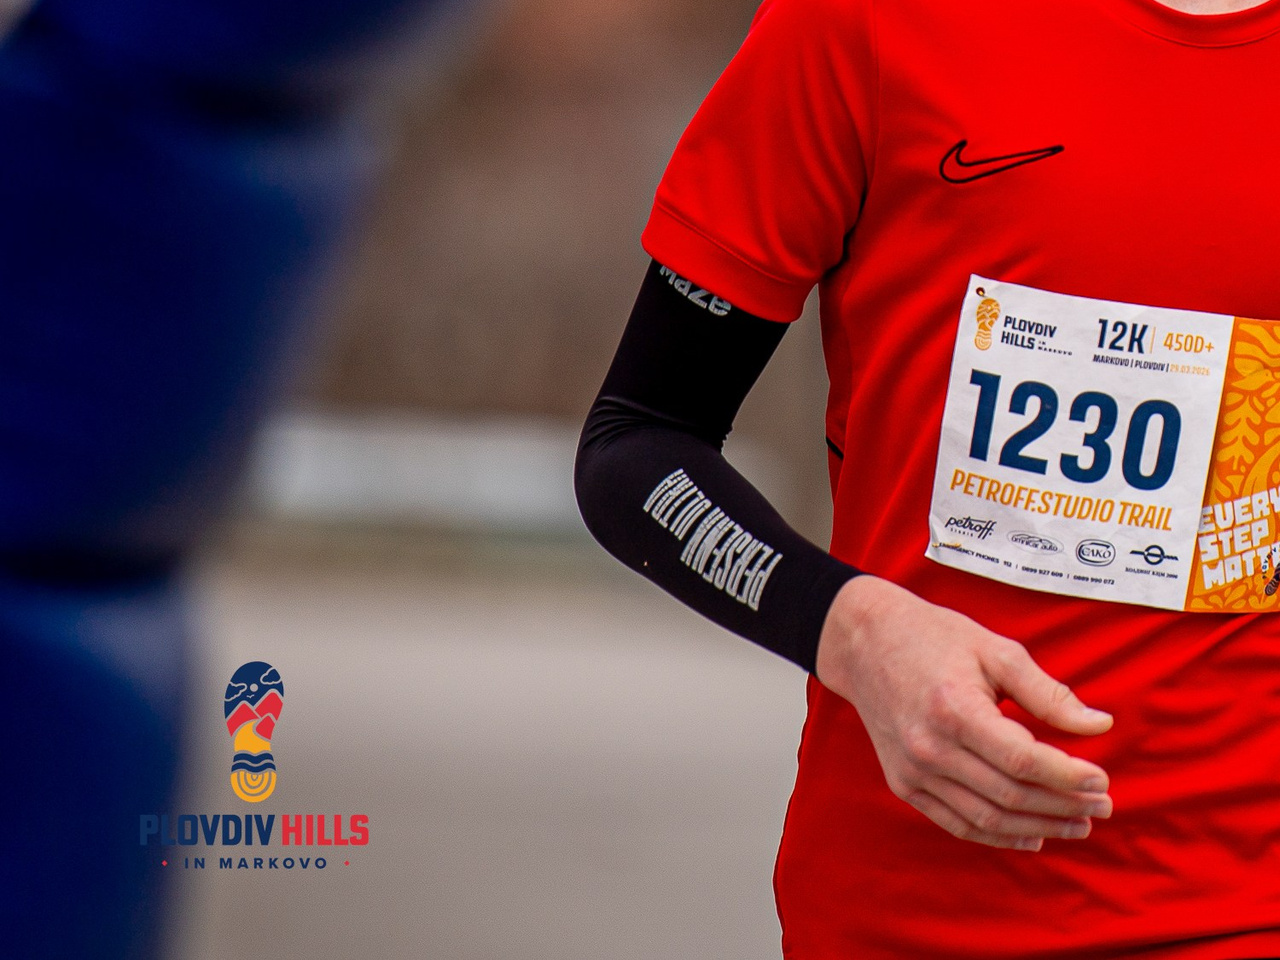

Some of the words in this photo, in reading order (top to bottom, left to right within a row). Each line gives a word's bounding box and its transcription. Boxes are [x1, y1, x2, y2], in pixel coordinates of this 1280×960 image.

[1000, 331, 1036, 350] HILLS
[1003, 315, 1057, 338] PLOVDIV
[1097, 318, 1149, 354] 12K
[1163, 332, 1215, 353] 450D+
[1092, 354, 1130, 367] MARKOVO
[1134, 359, 1165, 372] PLOVDIV
[968, 368, 1182, 491] 1230
[642, 467, 713, 541] ULTRA
[1117, 500, 1173, 531] TRAIL
[1198, 518, 1270, 563] STEP
[679, 506, 784, 612] PERSENK
